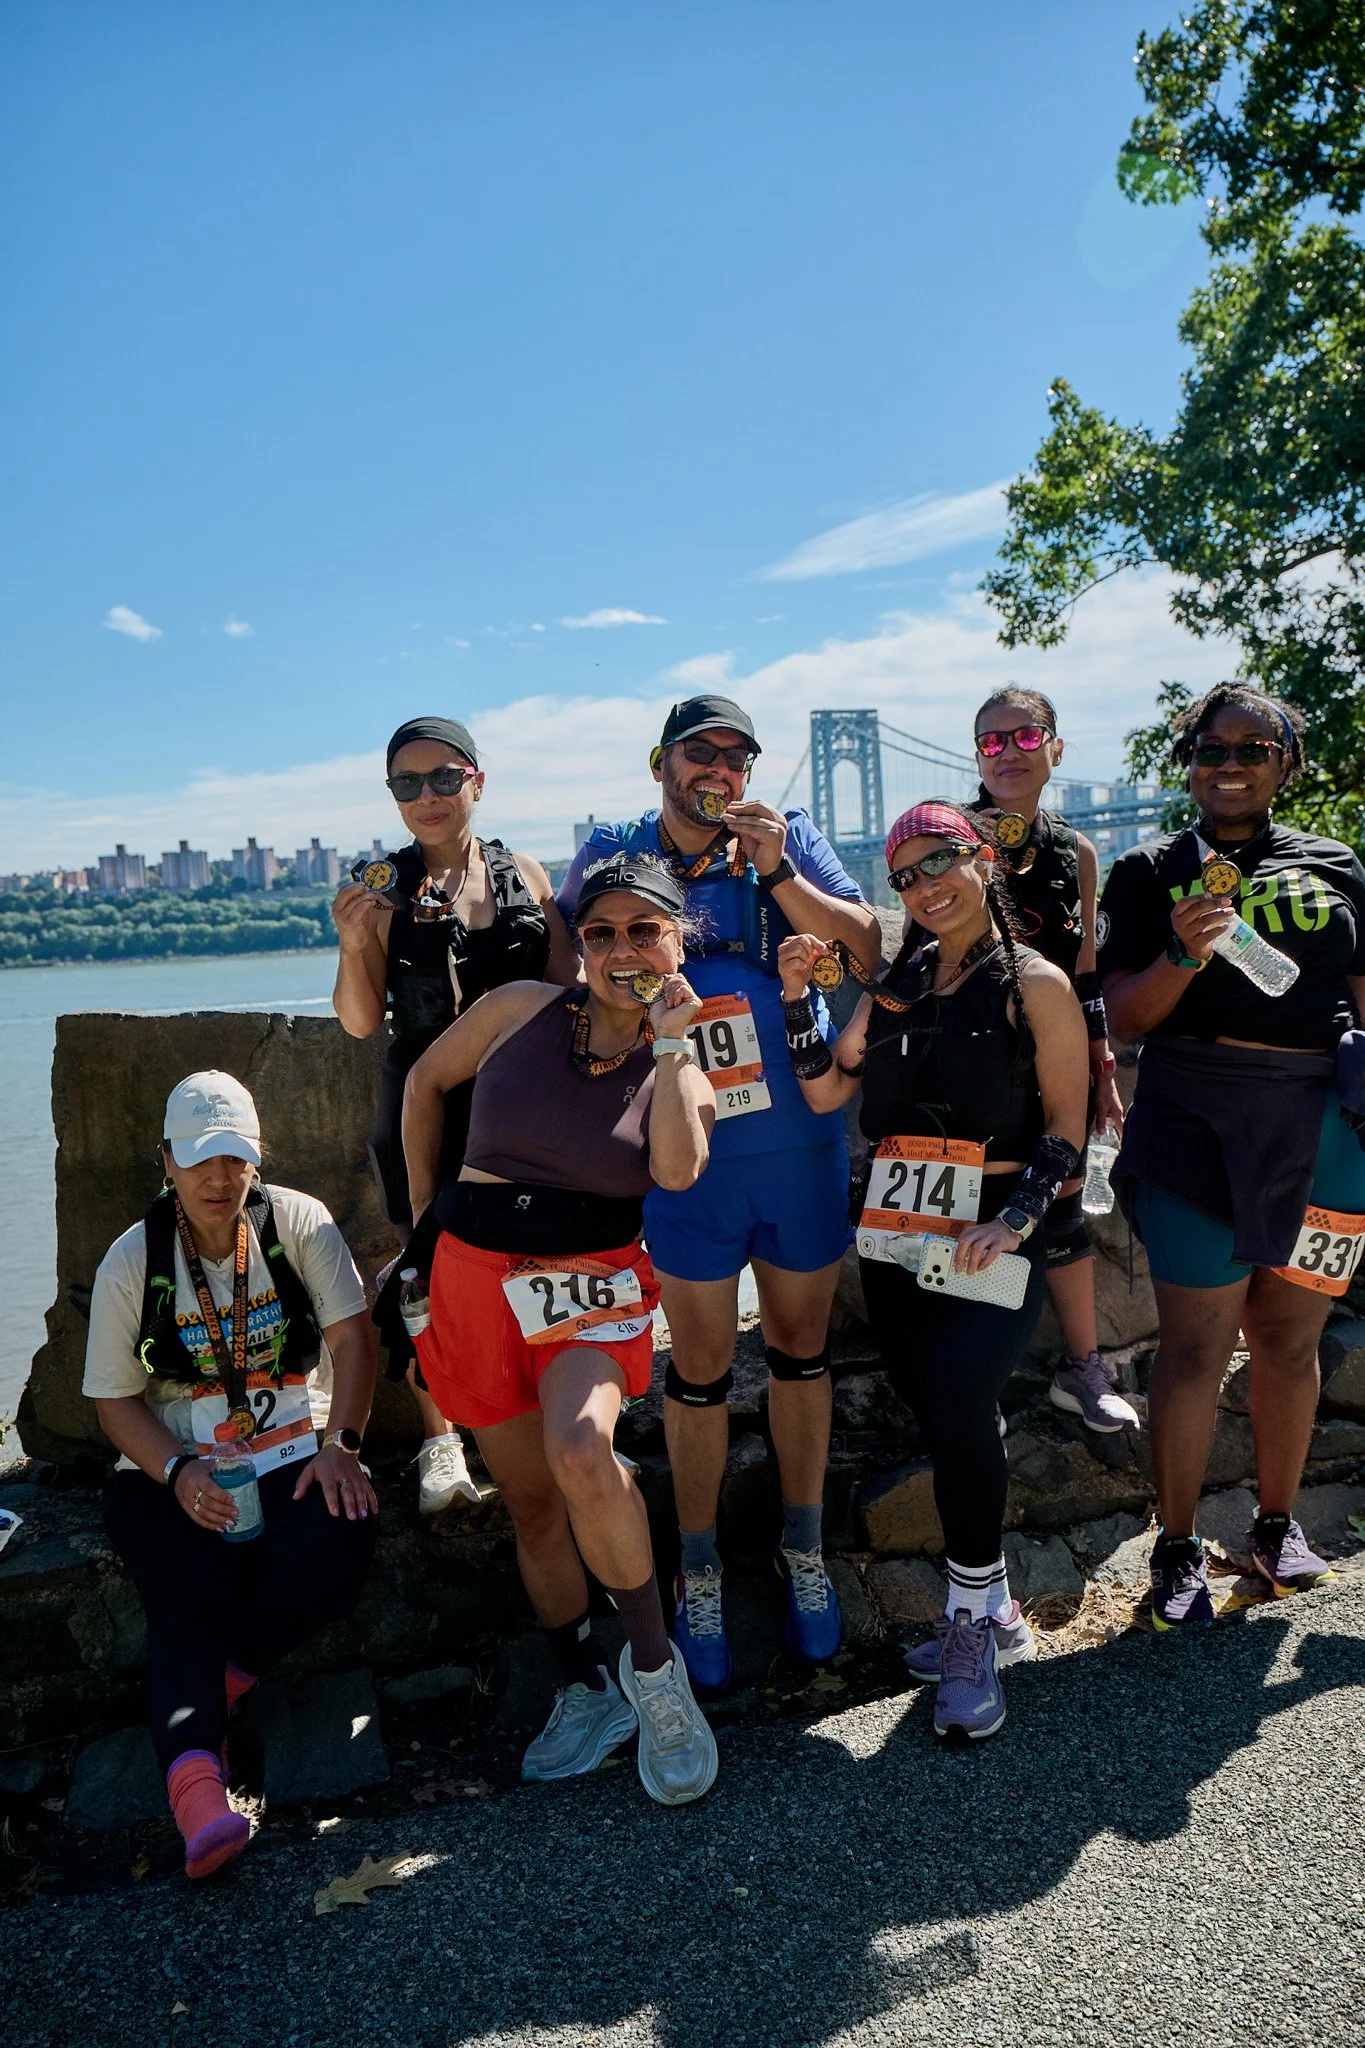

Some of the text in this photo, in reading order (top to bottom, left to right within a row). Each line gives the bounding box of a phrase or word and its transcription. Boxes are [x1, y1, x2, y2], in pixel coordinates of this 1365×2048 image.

[759, 906, 769, 961] NATHAN
[687, 1020, 738, 1073] 19
[785, 1023, 820, 1051] LITE
[726, 1089, 751, 1108] 219
[928, 1141, 968, 1151] Paliades
[880, 1160, 956, 1217] 214
[529, 1274, 616, 1327] 216
[234, 1334, 245, 1369] 2026
[253, 1389, 277, 1436] 2
[280, 1445, 295, 1459] 82
